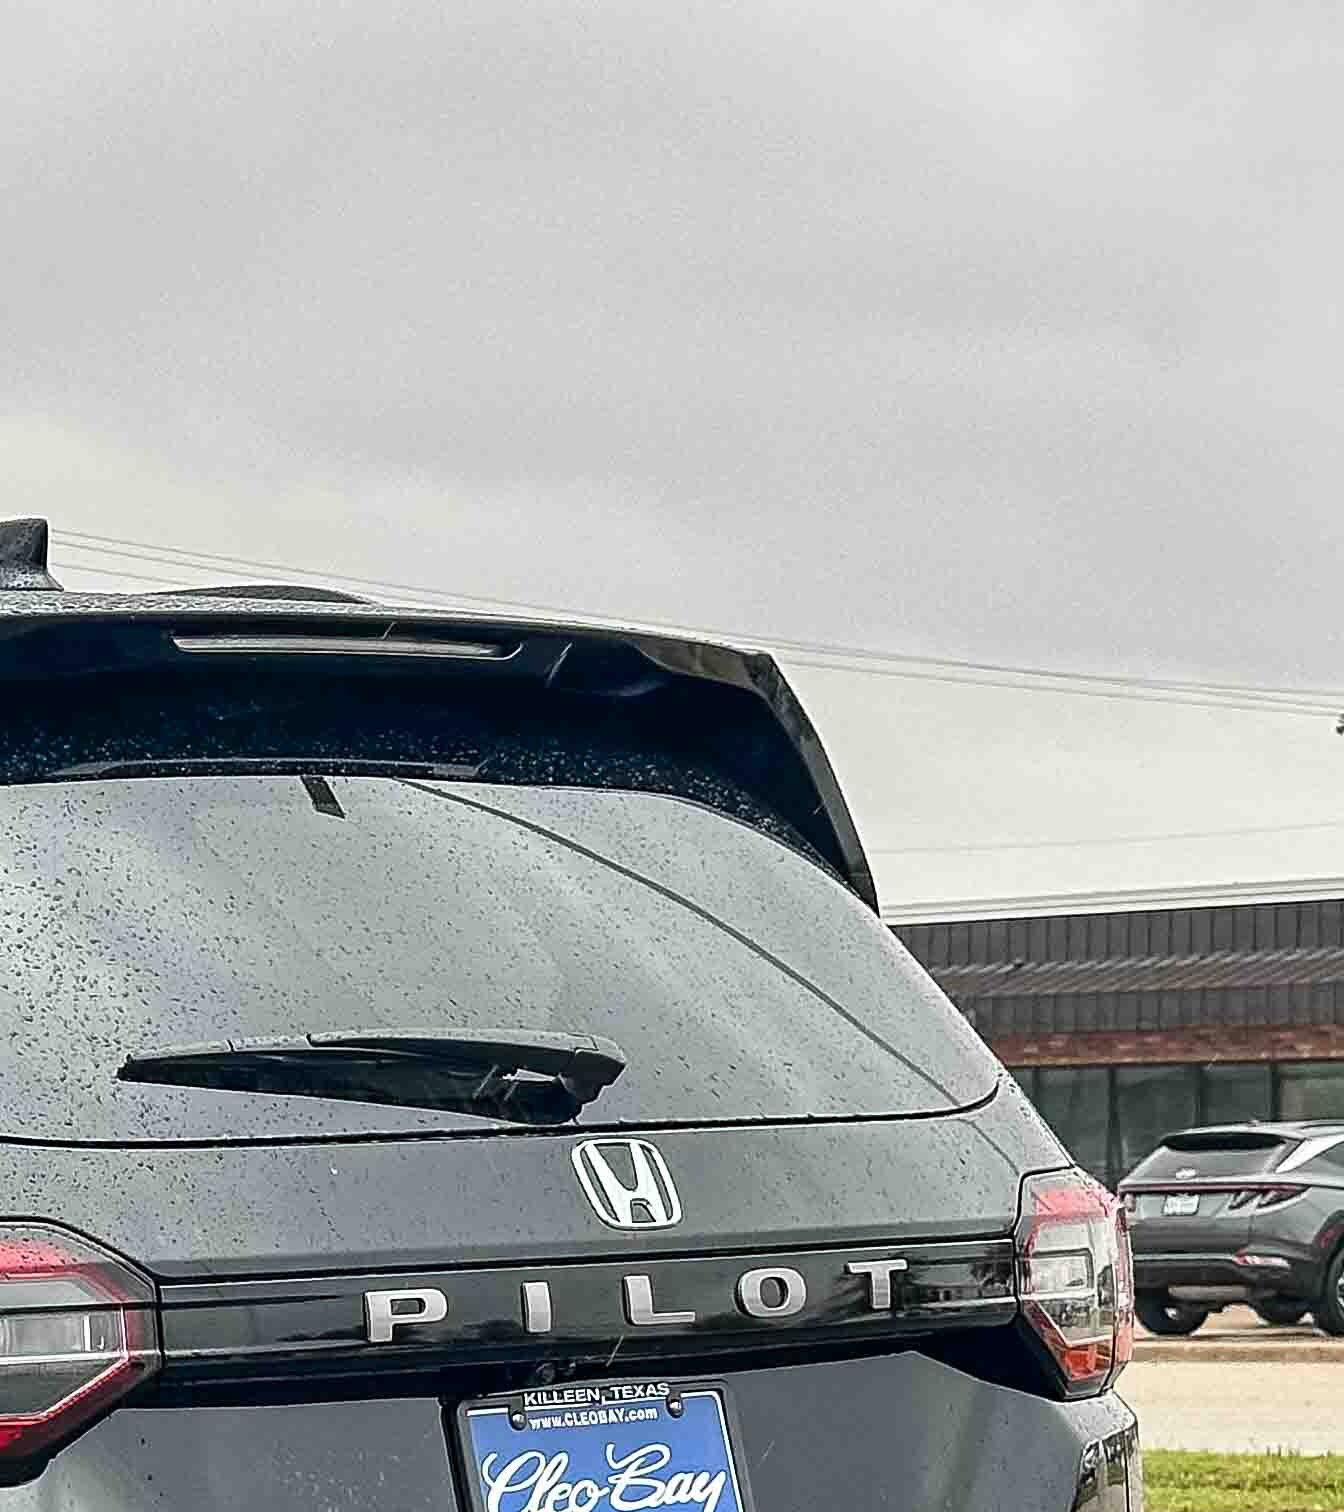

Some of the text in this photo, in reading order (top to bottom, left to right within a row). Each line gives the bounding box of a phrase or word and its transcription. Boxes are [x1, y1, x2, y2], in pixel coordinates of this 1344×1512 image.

[363, 1257, 908, 1343] PILOT
[523, 1382, 670, 1406] KILLEEN, TEXAS
[528, 1407, 659, 1431] www.CLEOBAY.com
